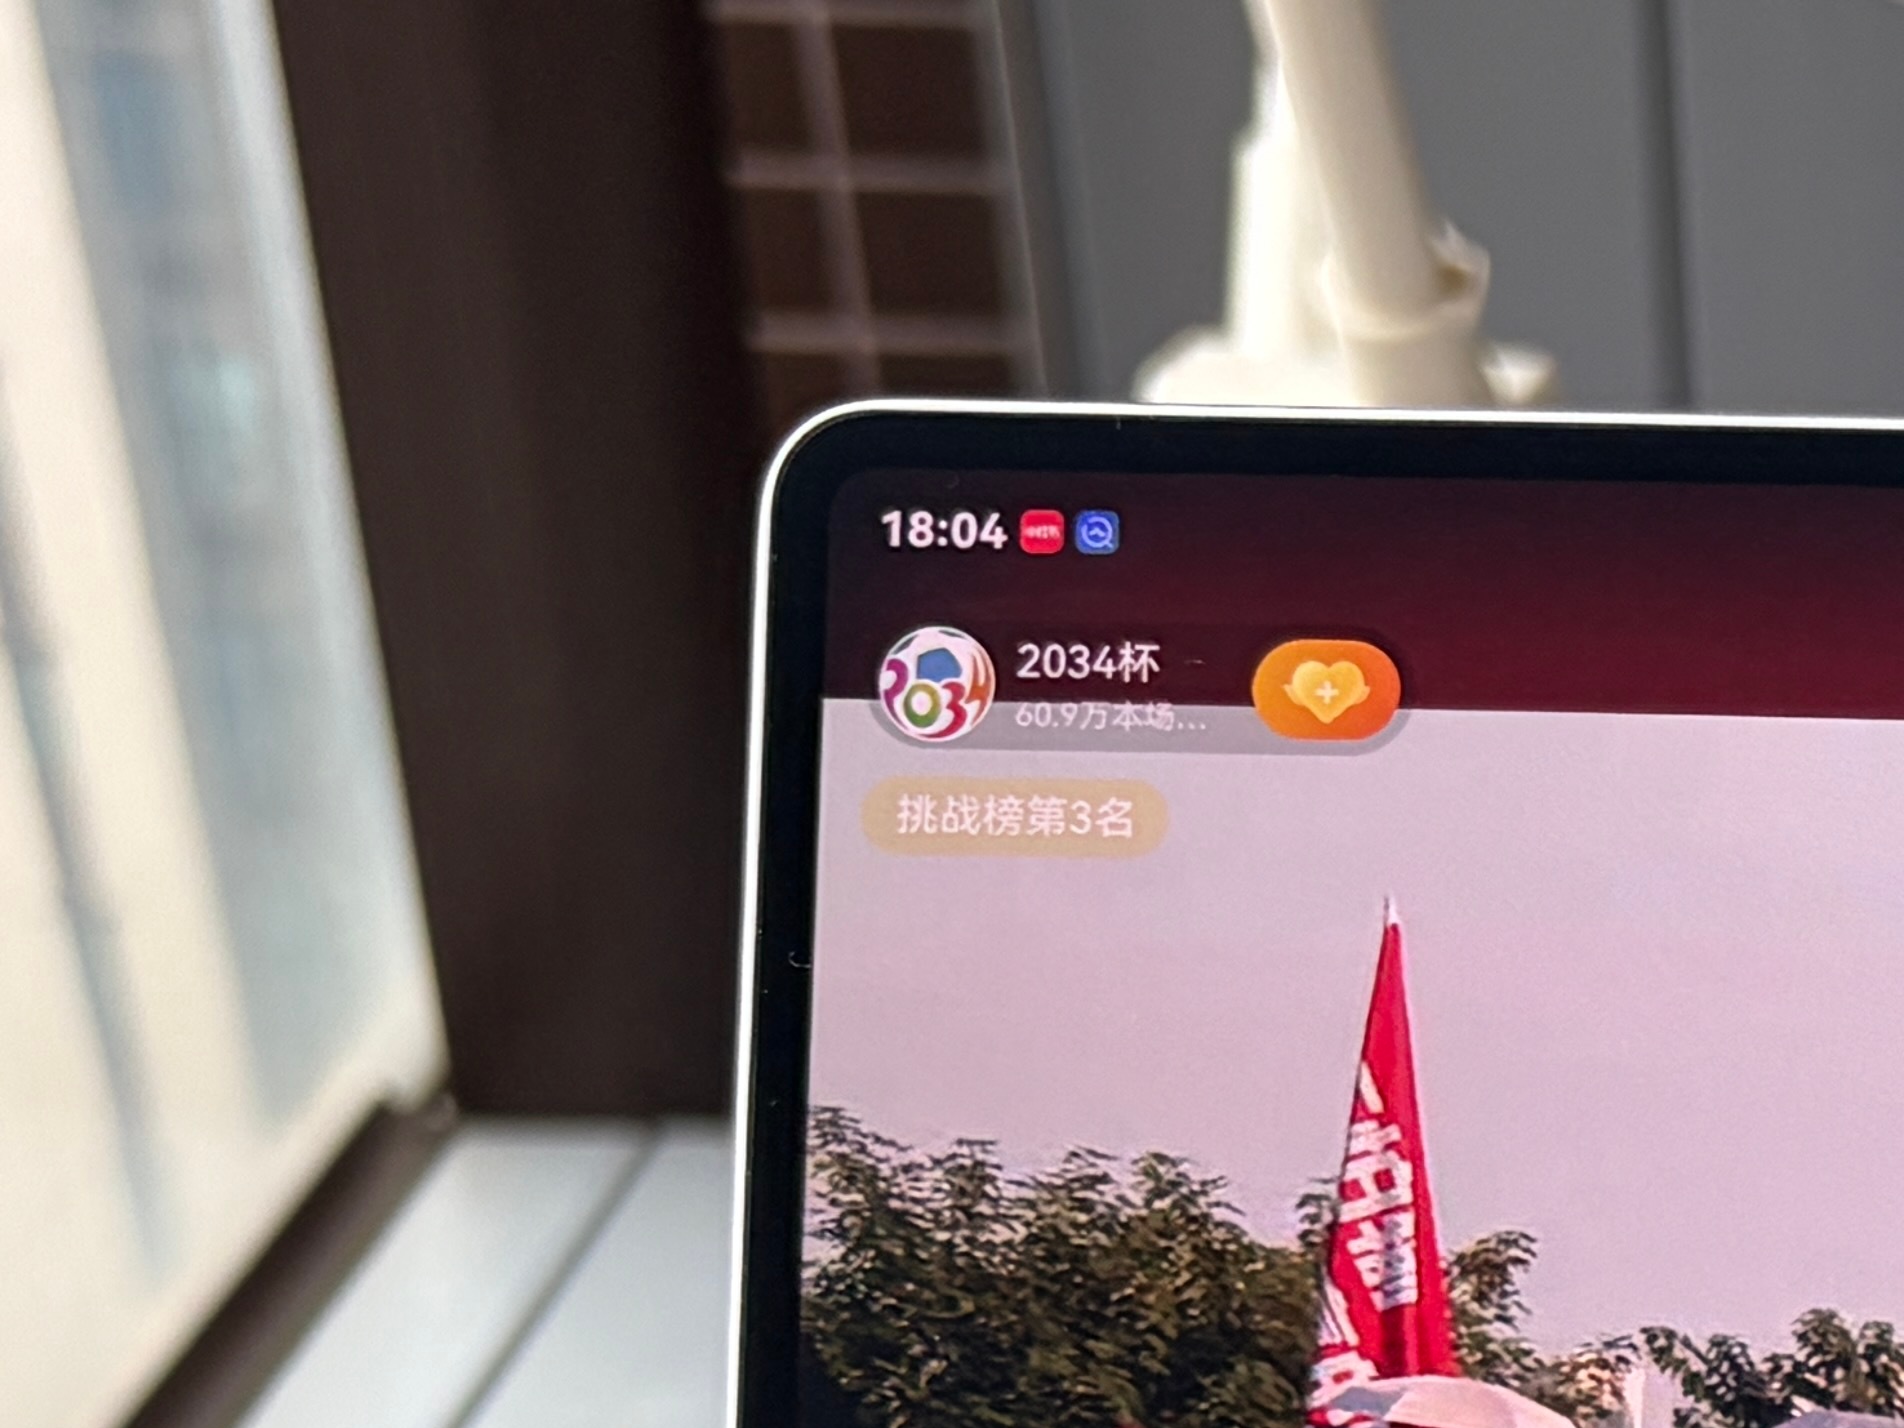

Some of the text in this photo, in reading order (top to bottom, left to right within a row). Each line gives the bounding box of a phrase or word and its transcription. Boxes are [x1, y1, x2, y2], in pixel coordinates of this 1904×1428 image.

[881, 510, 1008, 549] 18:04
[1015, 641, 1161, 684] 2034杯
[1014, 701, 1207, 733] 60.9万本场...
[896, 794, 1134, 838] 挑战榜第3名
